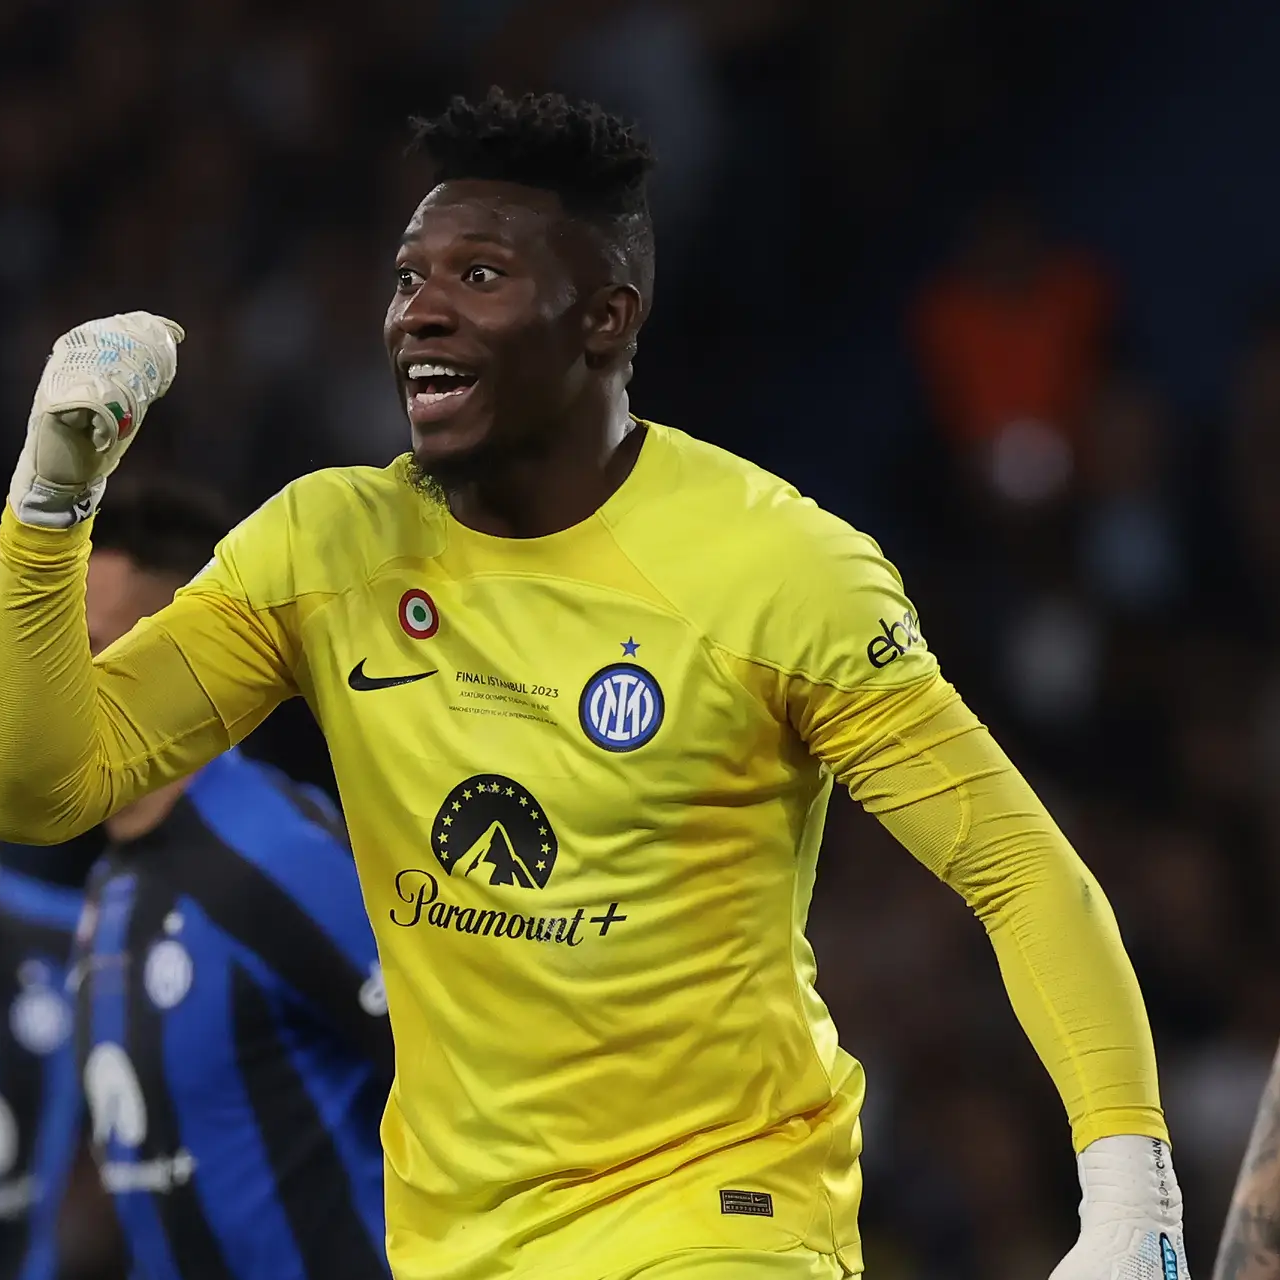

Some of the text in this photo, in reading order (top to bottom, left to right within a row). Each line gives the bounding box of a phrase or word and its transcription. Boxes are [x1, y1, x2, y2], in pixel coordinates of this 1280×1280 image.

[455, 671, 559, 698] FINAL ISTANBUL 2023
